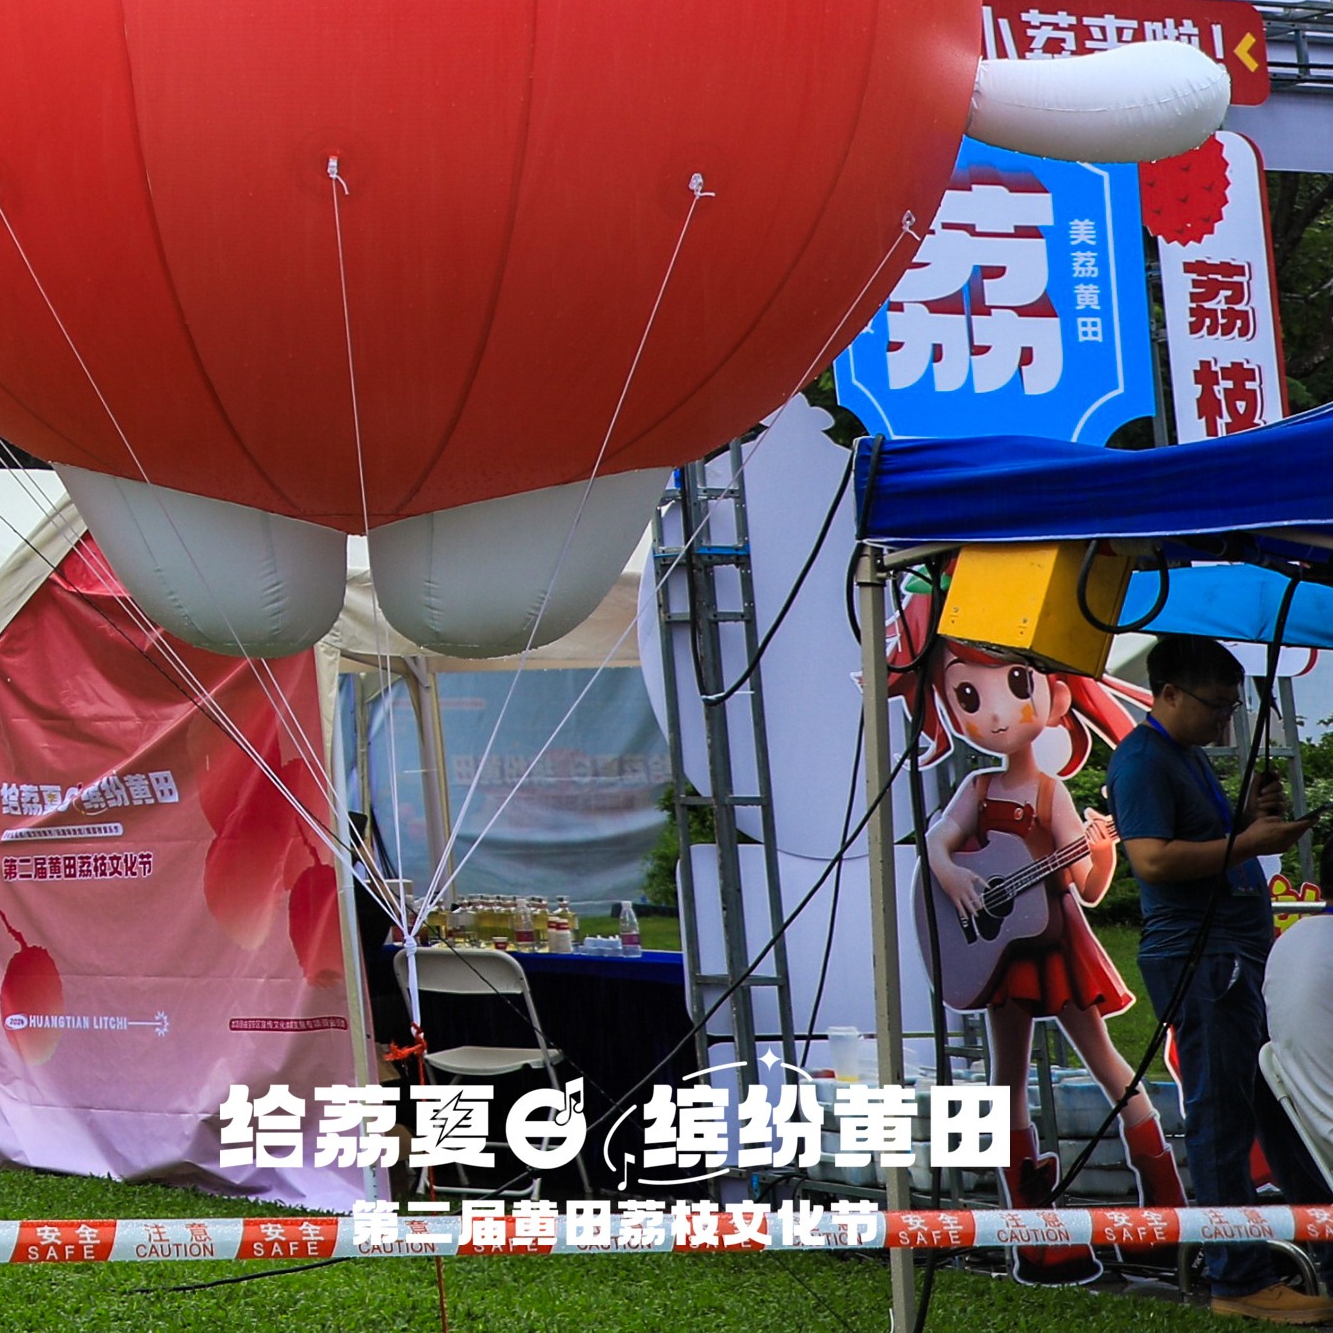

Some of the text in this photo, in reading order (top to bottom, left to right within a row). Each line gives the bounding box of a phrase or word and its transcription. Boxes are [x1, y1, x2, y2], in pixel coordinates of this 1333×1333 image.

[1069, 218, 1104, 344] 美荔黄田
[1183, 258, 1266, 438] 荔枝
[2, 851, 153, 881] 第二届黄田荔枝文化节
[29, 1014, 89, 1029] HUANGTIAN
[93, 1016, 128, 1030] LITCHI
[901, 1212, 964, 1232] 安全
[999, 1210, 1066, 1229] 注意
[1103, 1209, 1168, 1228] 安全
[37, 1224, 101, 1246] 安全
[143, 1222, 212, 1244] 注意
[259, 1221, 325, 1242] 安全
[899, 1231, 962, 1245] SAFE
[997, 1228, 1071, 1243] CAUTION
[1104, 1227, 1167, 1241] SAFE
[1201, 1224, 1275, 1239] CAUTION
[27, 1245, 96, 1260] SAFE
[135, 1243, 214, 1258] CAUTION
[252, 1241, 319, 1256] SAFE
